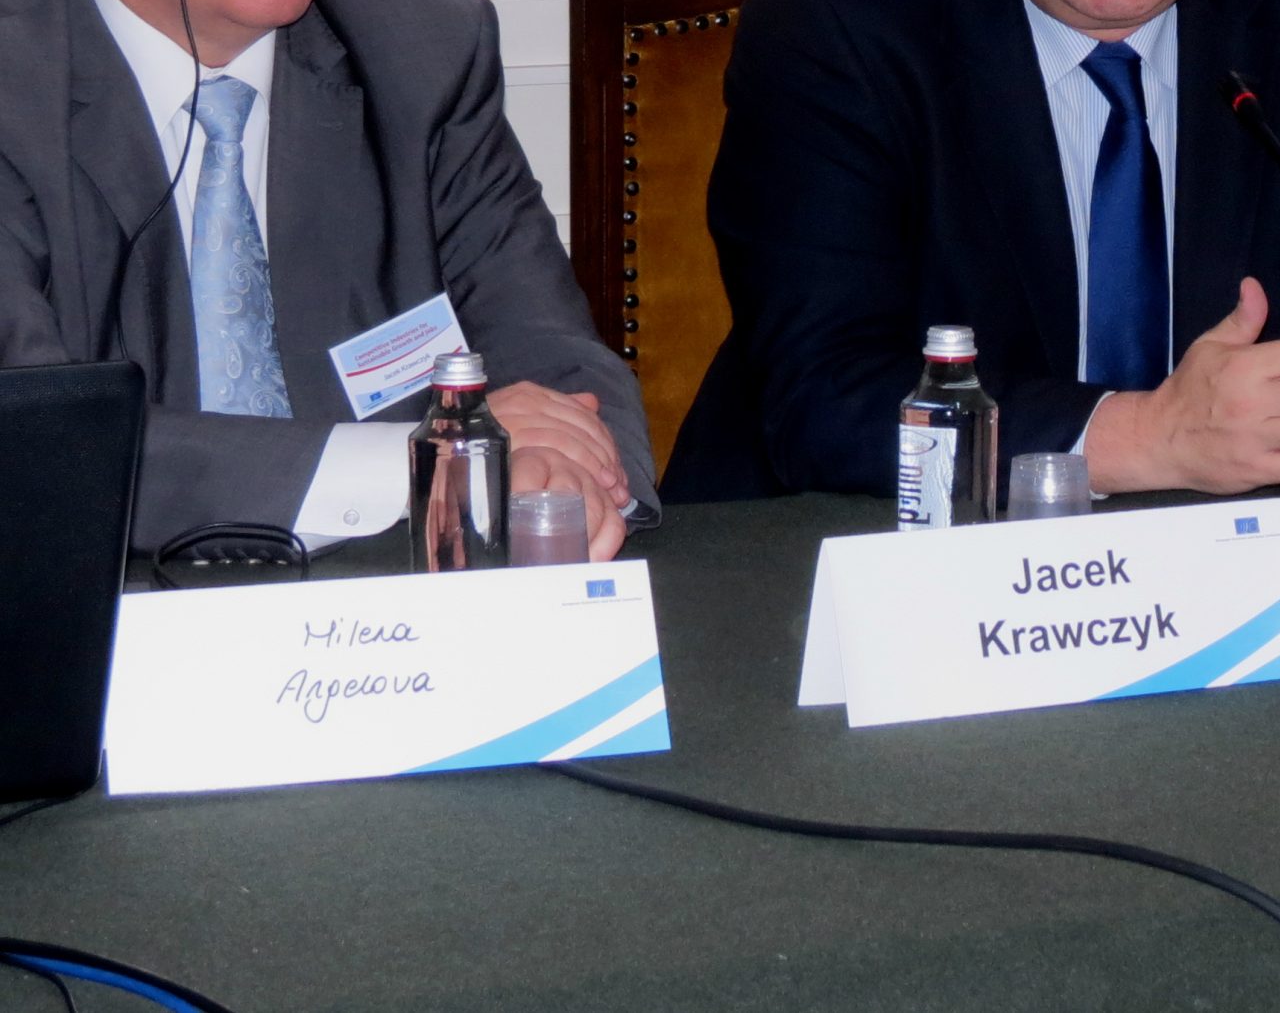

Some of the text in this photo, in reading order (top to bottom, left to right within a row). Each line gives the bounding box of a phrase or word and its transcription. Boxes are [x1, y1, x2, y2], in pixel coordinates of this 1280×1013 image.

[1013, 550, 1130, 594] Jacek
[304, 618, 419, 647] Milena
[979, 603, 1179, 658] Krawczyk
